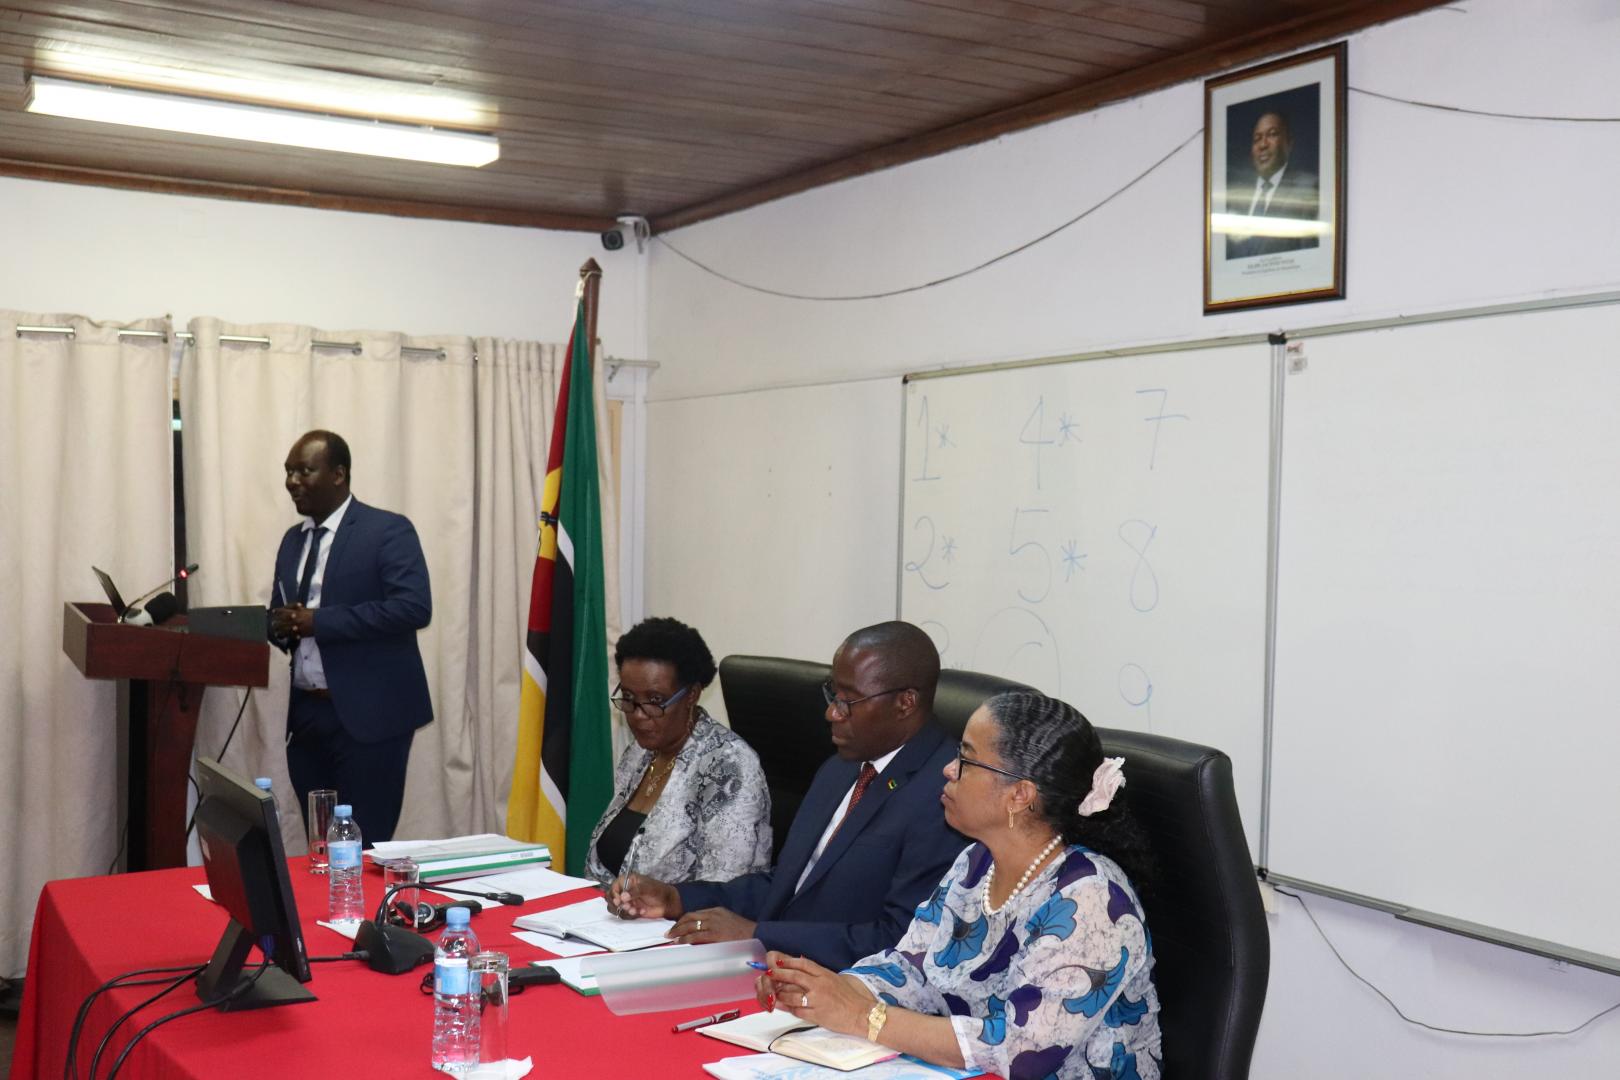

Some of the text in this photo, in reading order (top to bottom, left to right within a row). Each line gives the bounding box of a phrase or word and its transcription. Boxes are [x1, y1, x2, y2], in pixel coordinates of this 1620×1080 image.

[1135, 388, 1191, 471] 7
[1118, 519, 1160, 613] 8
[1118, 662, 1154, 730] 9
